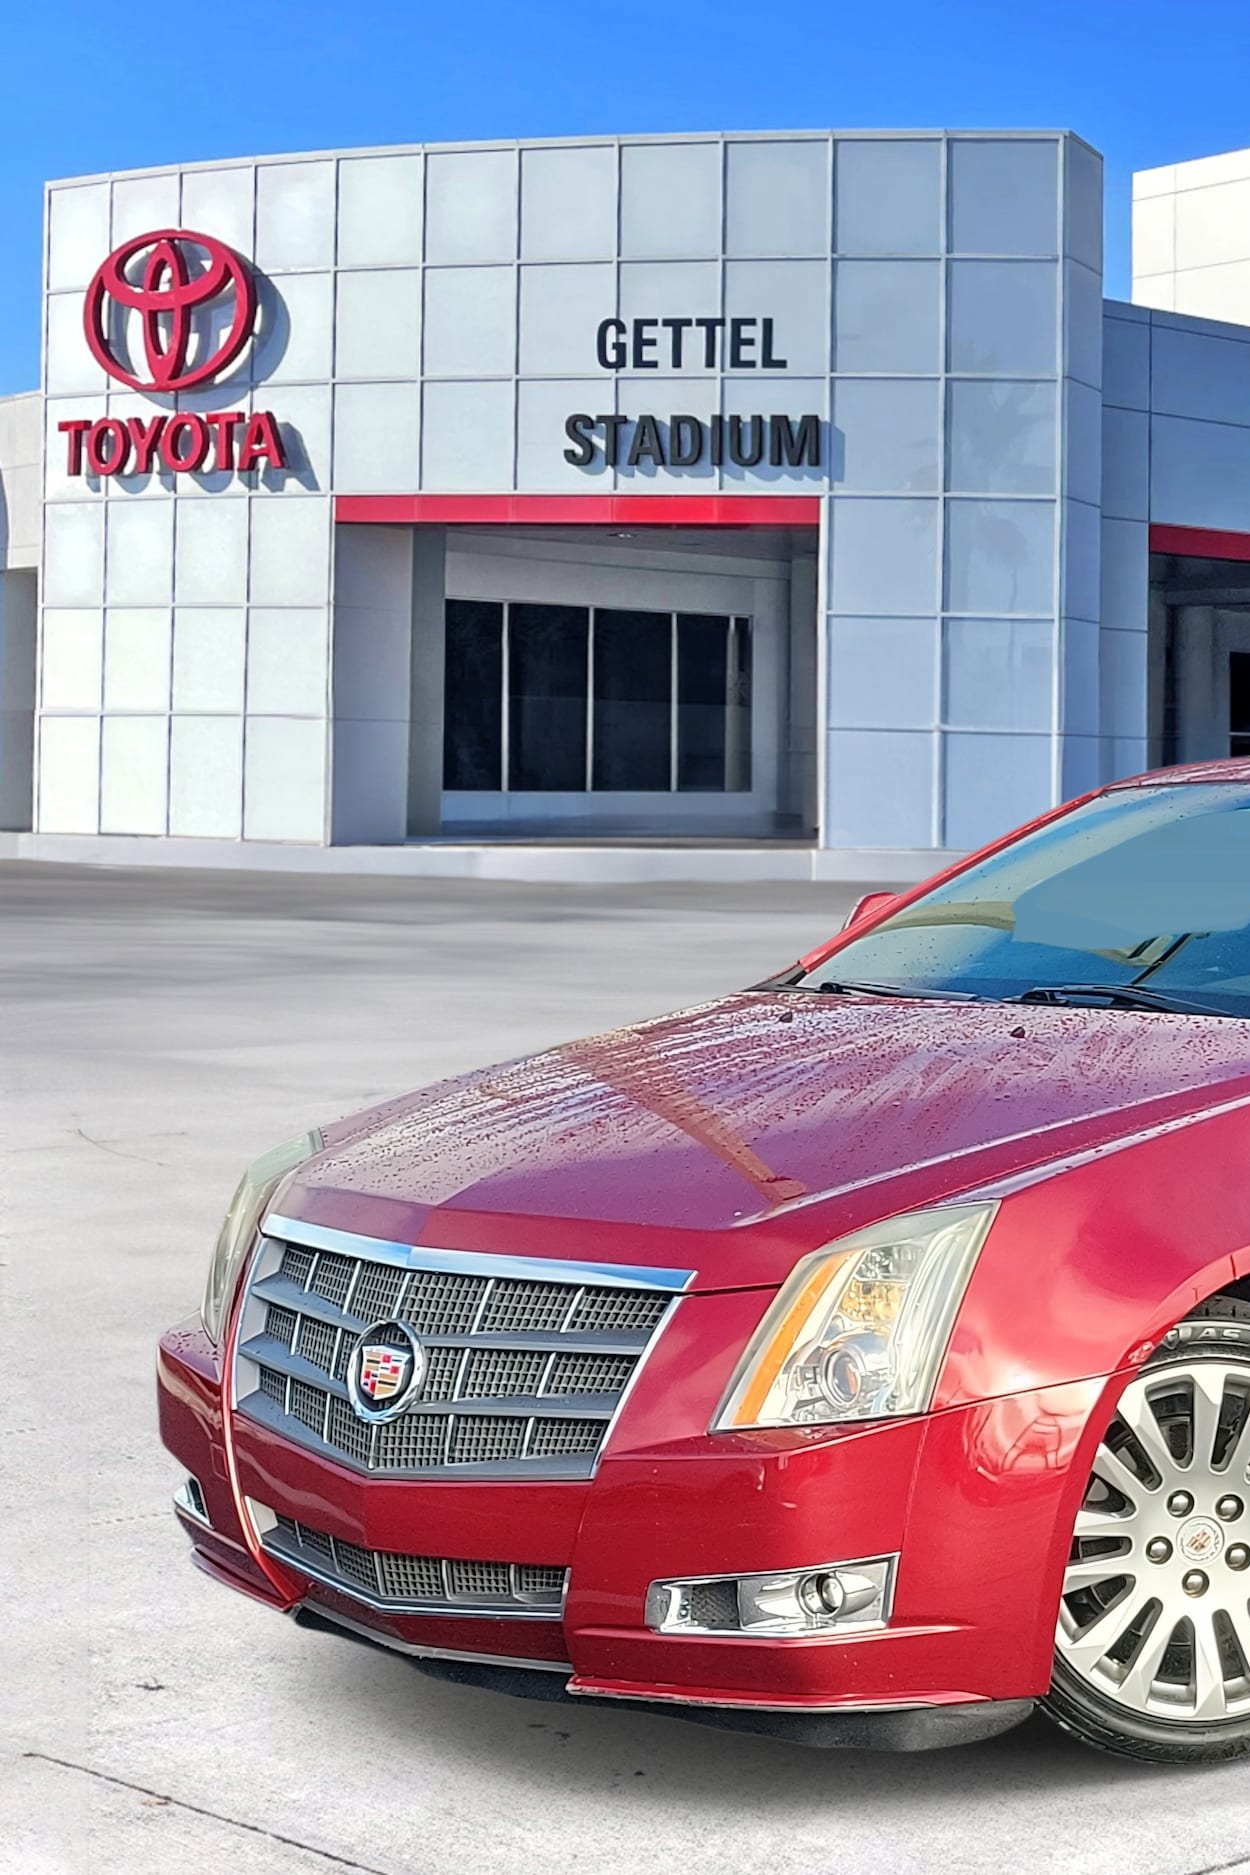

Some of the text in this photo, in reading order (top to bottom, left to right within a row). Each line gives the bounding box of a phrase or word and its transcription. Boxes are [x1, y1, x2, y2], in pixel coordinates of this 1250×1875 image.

[597, 318, 787, 369] GETTEL
[58, 411, 288, 476] TOYOTA
[563, 413, 820, 467] STADIUM
